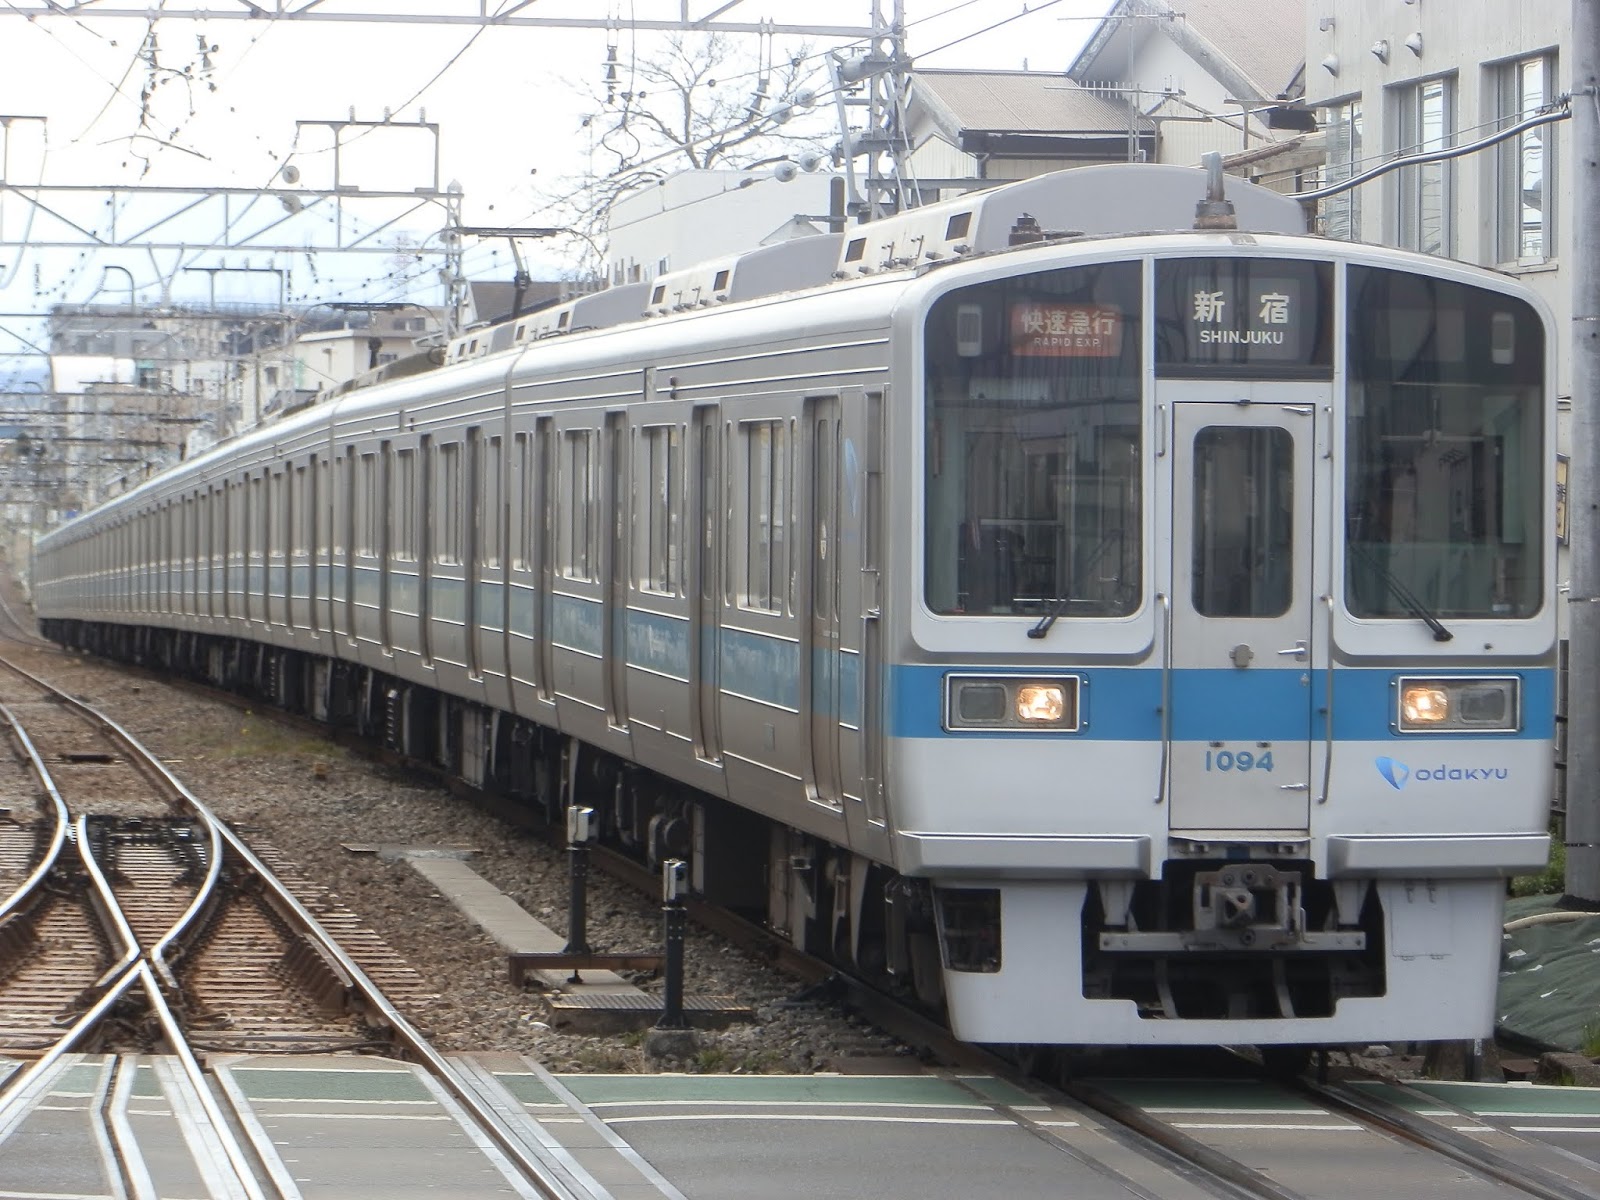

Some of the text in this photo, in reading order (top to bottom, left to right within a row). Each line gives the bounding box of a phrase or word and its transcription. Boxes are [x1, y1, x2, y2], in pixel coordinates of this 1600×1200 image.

[1021, 310, 1115, 334] 快速急行
[1033, 337, 1070, 347] RAPID
[1200, 330, 1284, 345] SHINJUKU
[1205, 751, 1274, 772] 1094
[1415, 763, 1508, 781] odakyu
